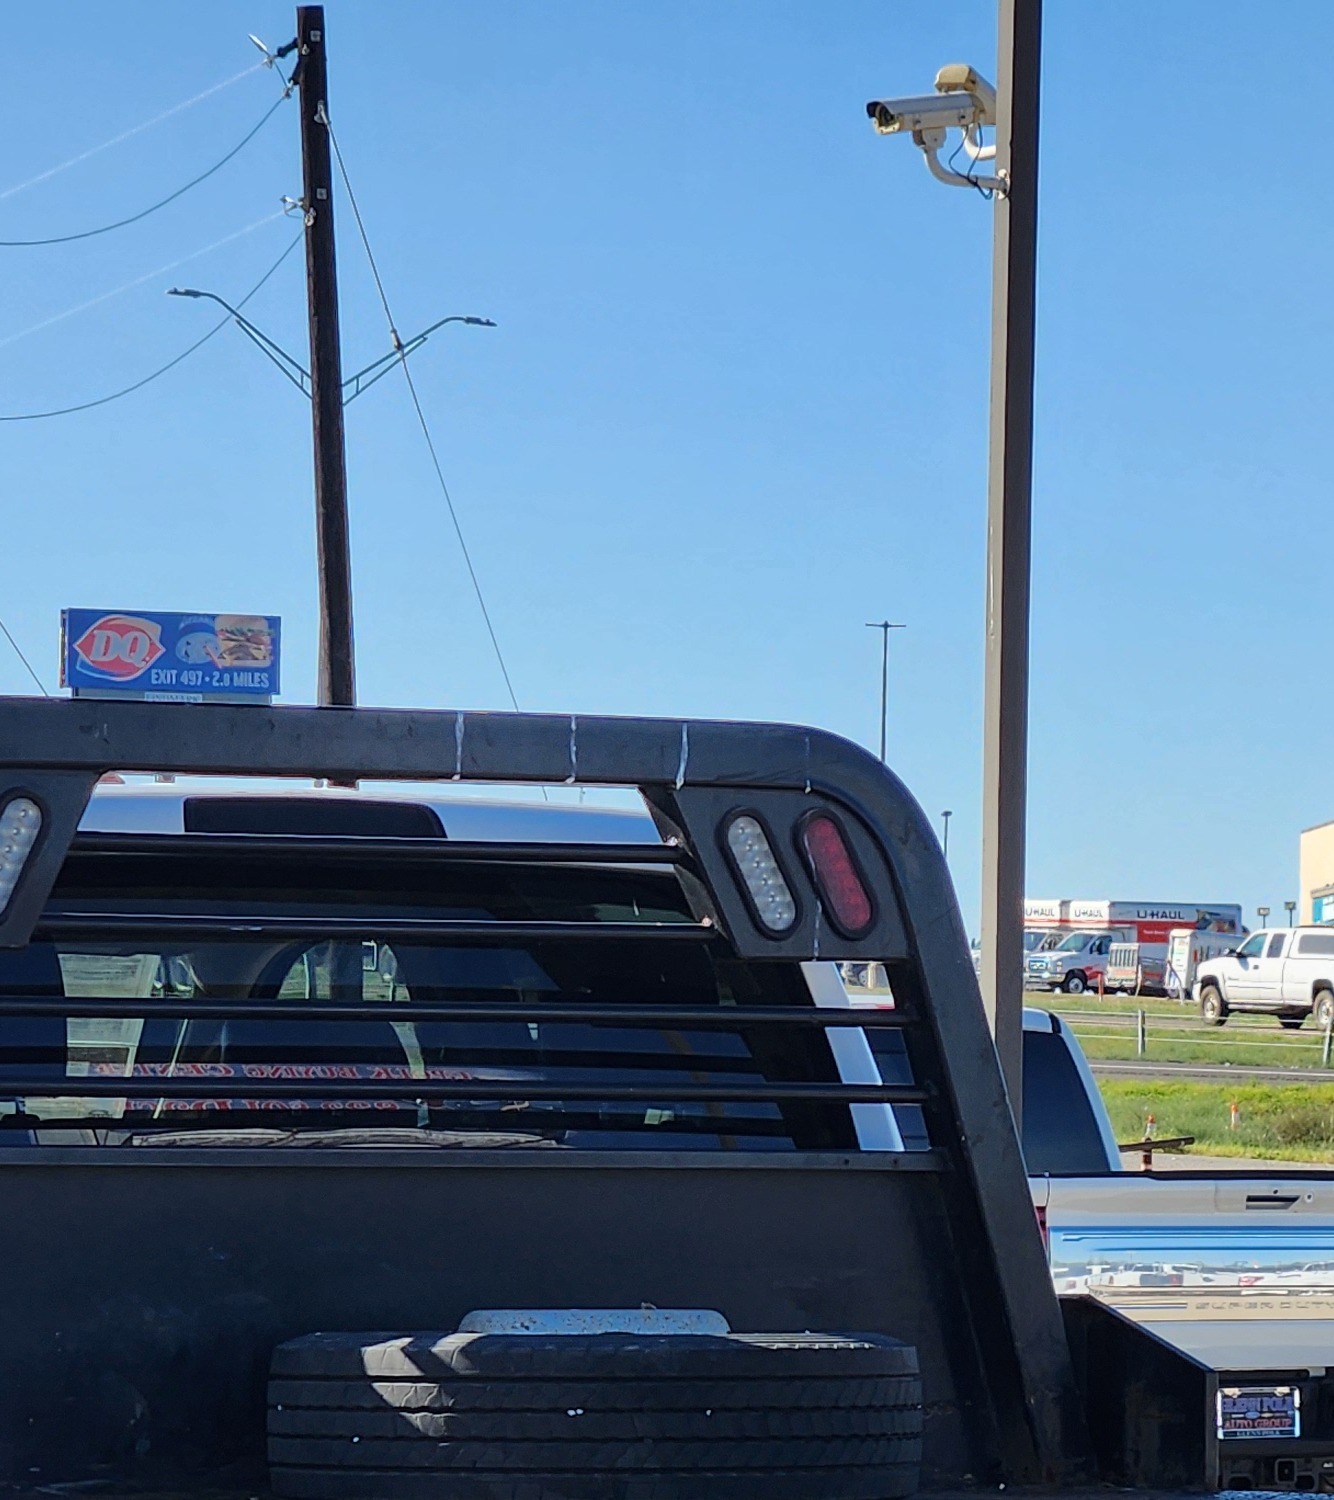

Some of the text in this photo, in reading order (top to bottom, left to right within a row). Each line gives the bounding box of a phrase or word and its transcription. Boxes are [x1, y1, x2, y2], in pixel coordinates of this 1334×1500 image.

[91, 629, 151, 668] DQ
[151, 669, 177, 685] EXIT
[180, 670, 203, 686] 497
[233, 672, 269, 688] MILES
[1137, 910, 1185, 920] U-HAUL
[1224, 1419, 1292, 1429] AUTO GROUP
